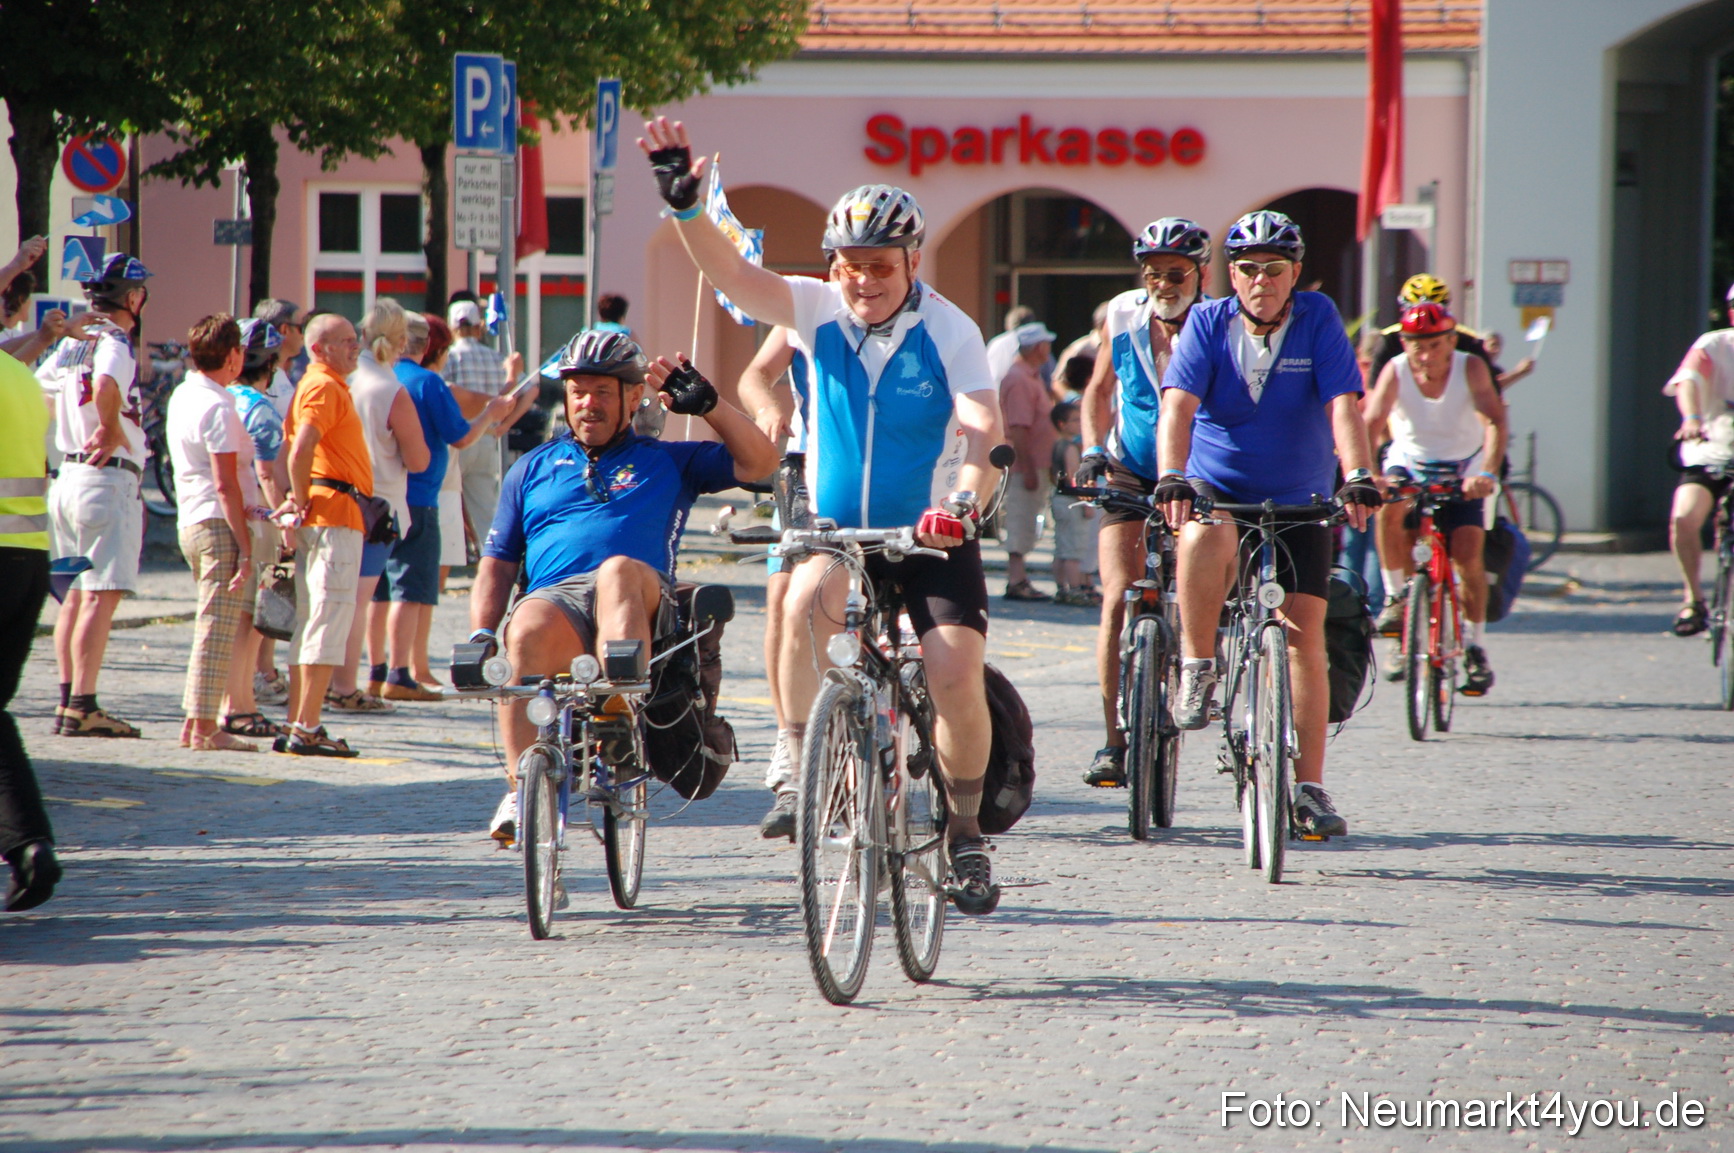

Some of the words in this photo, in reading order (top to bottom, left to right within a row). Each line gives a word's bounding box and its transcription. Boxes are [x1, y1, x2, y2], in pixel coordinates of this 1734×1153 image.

[465, 66, 492, 138] P
[601, 92, 615, 159] P
[864, 113, 1206, 176] Sparkasse
[458, 177, 499, 191] Parkschein
[464, 164, 477, 174] nur
[480, 163, 492, 175] mit
[461, 194, 496, 210] werktags
